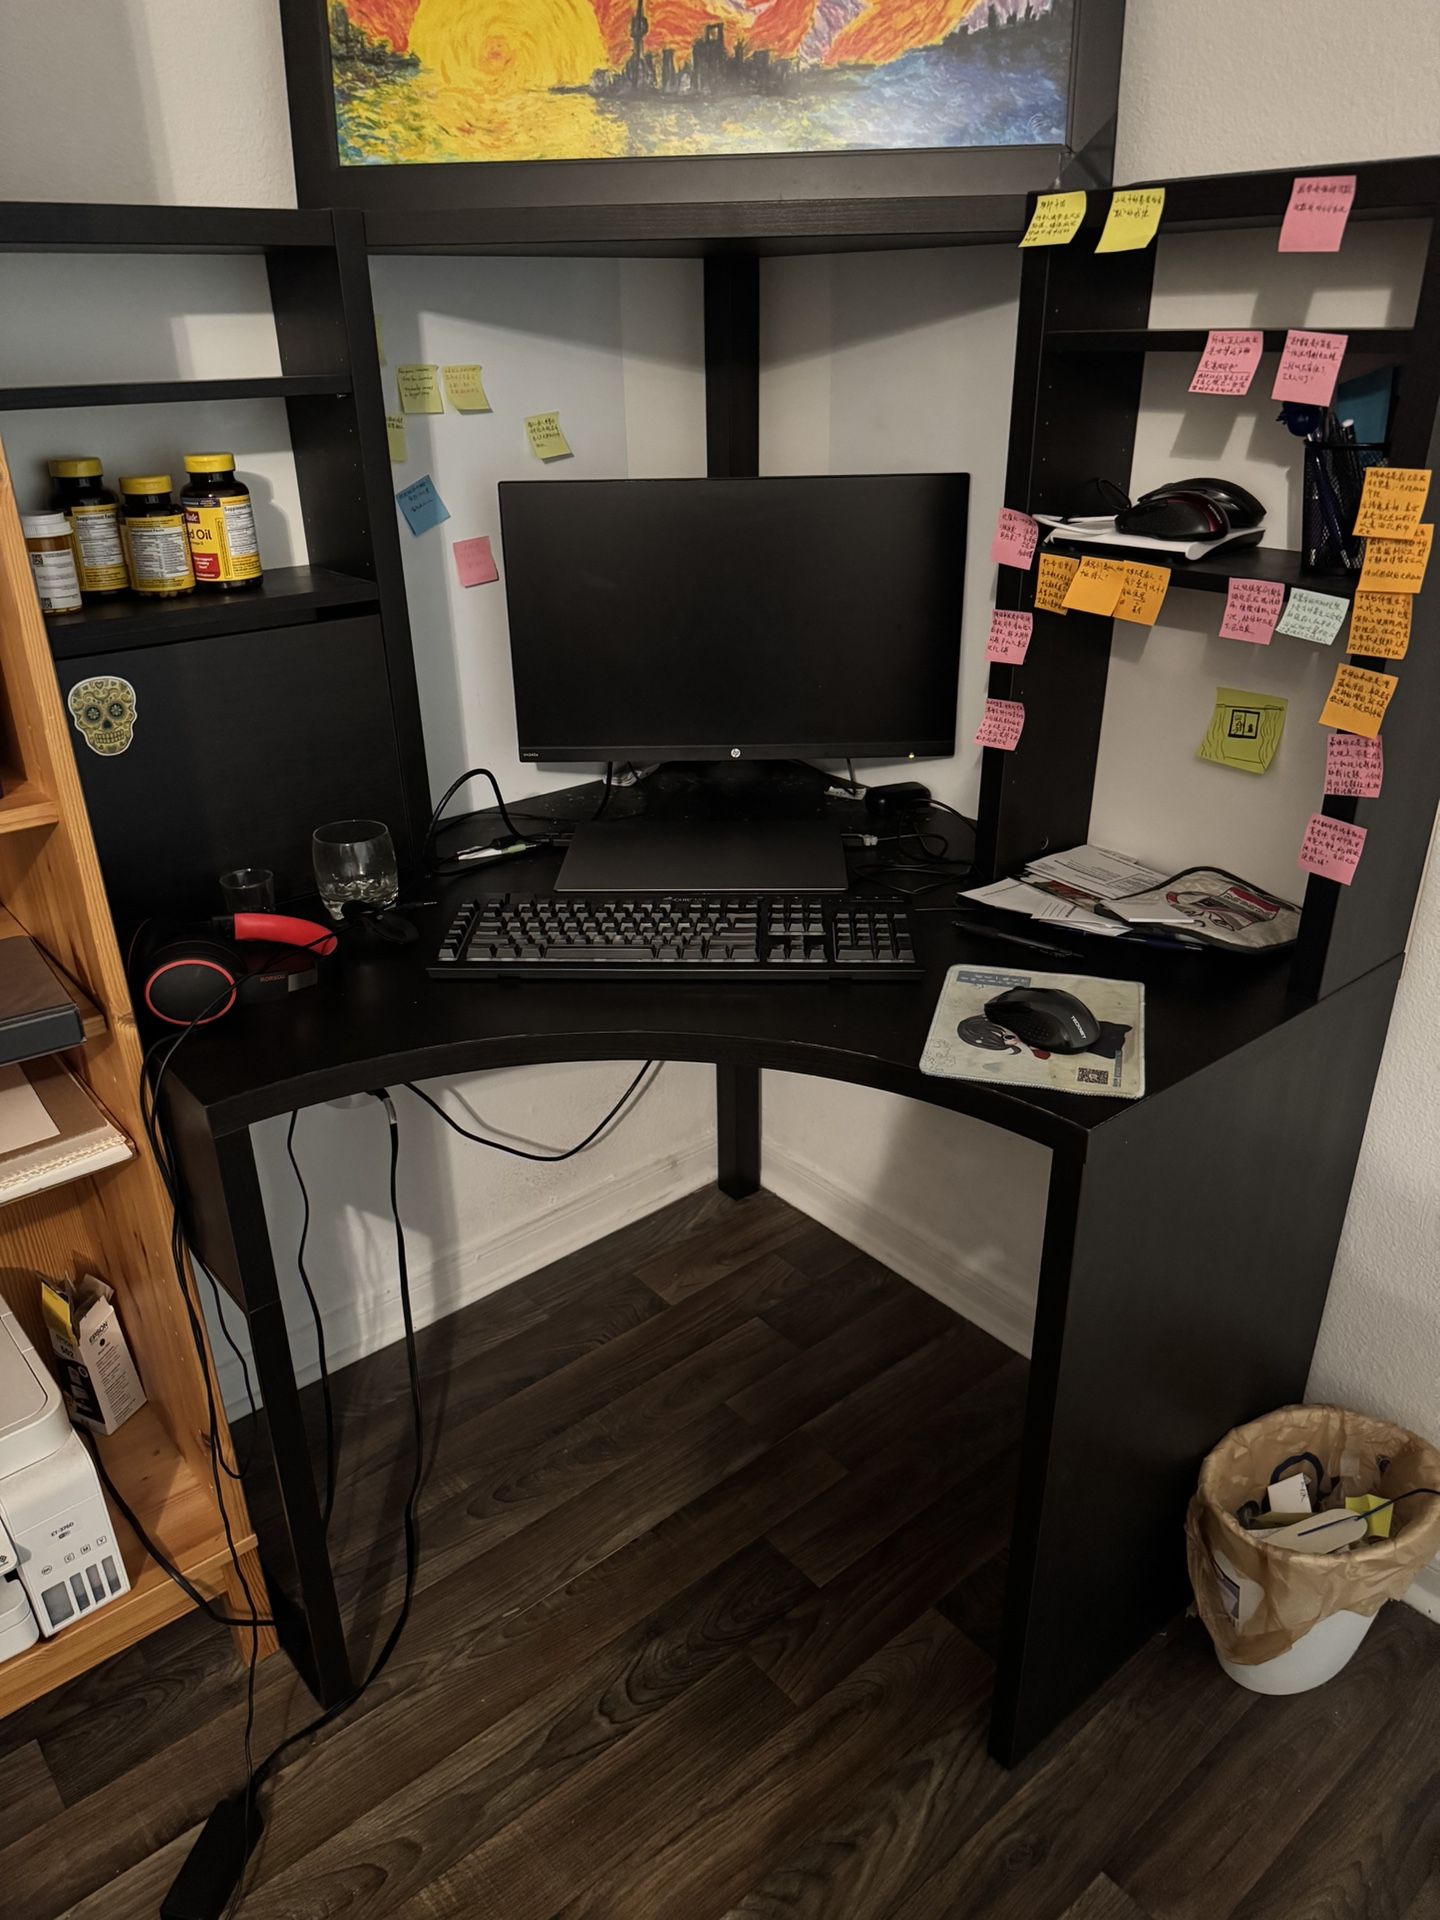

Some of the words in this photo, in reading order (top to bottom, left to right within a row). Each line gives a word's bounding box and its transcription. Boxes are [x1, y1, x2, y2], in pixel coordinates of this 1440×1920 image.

[196, 528, 212, 540] Oil
[1071, 1016, 1086, 1039] TECKNET
[88, 1321, 109, 1344] EPSON
